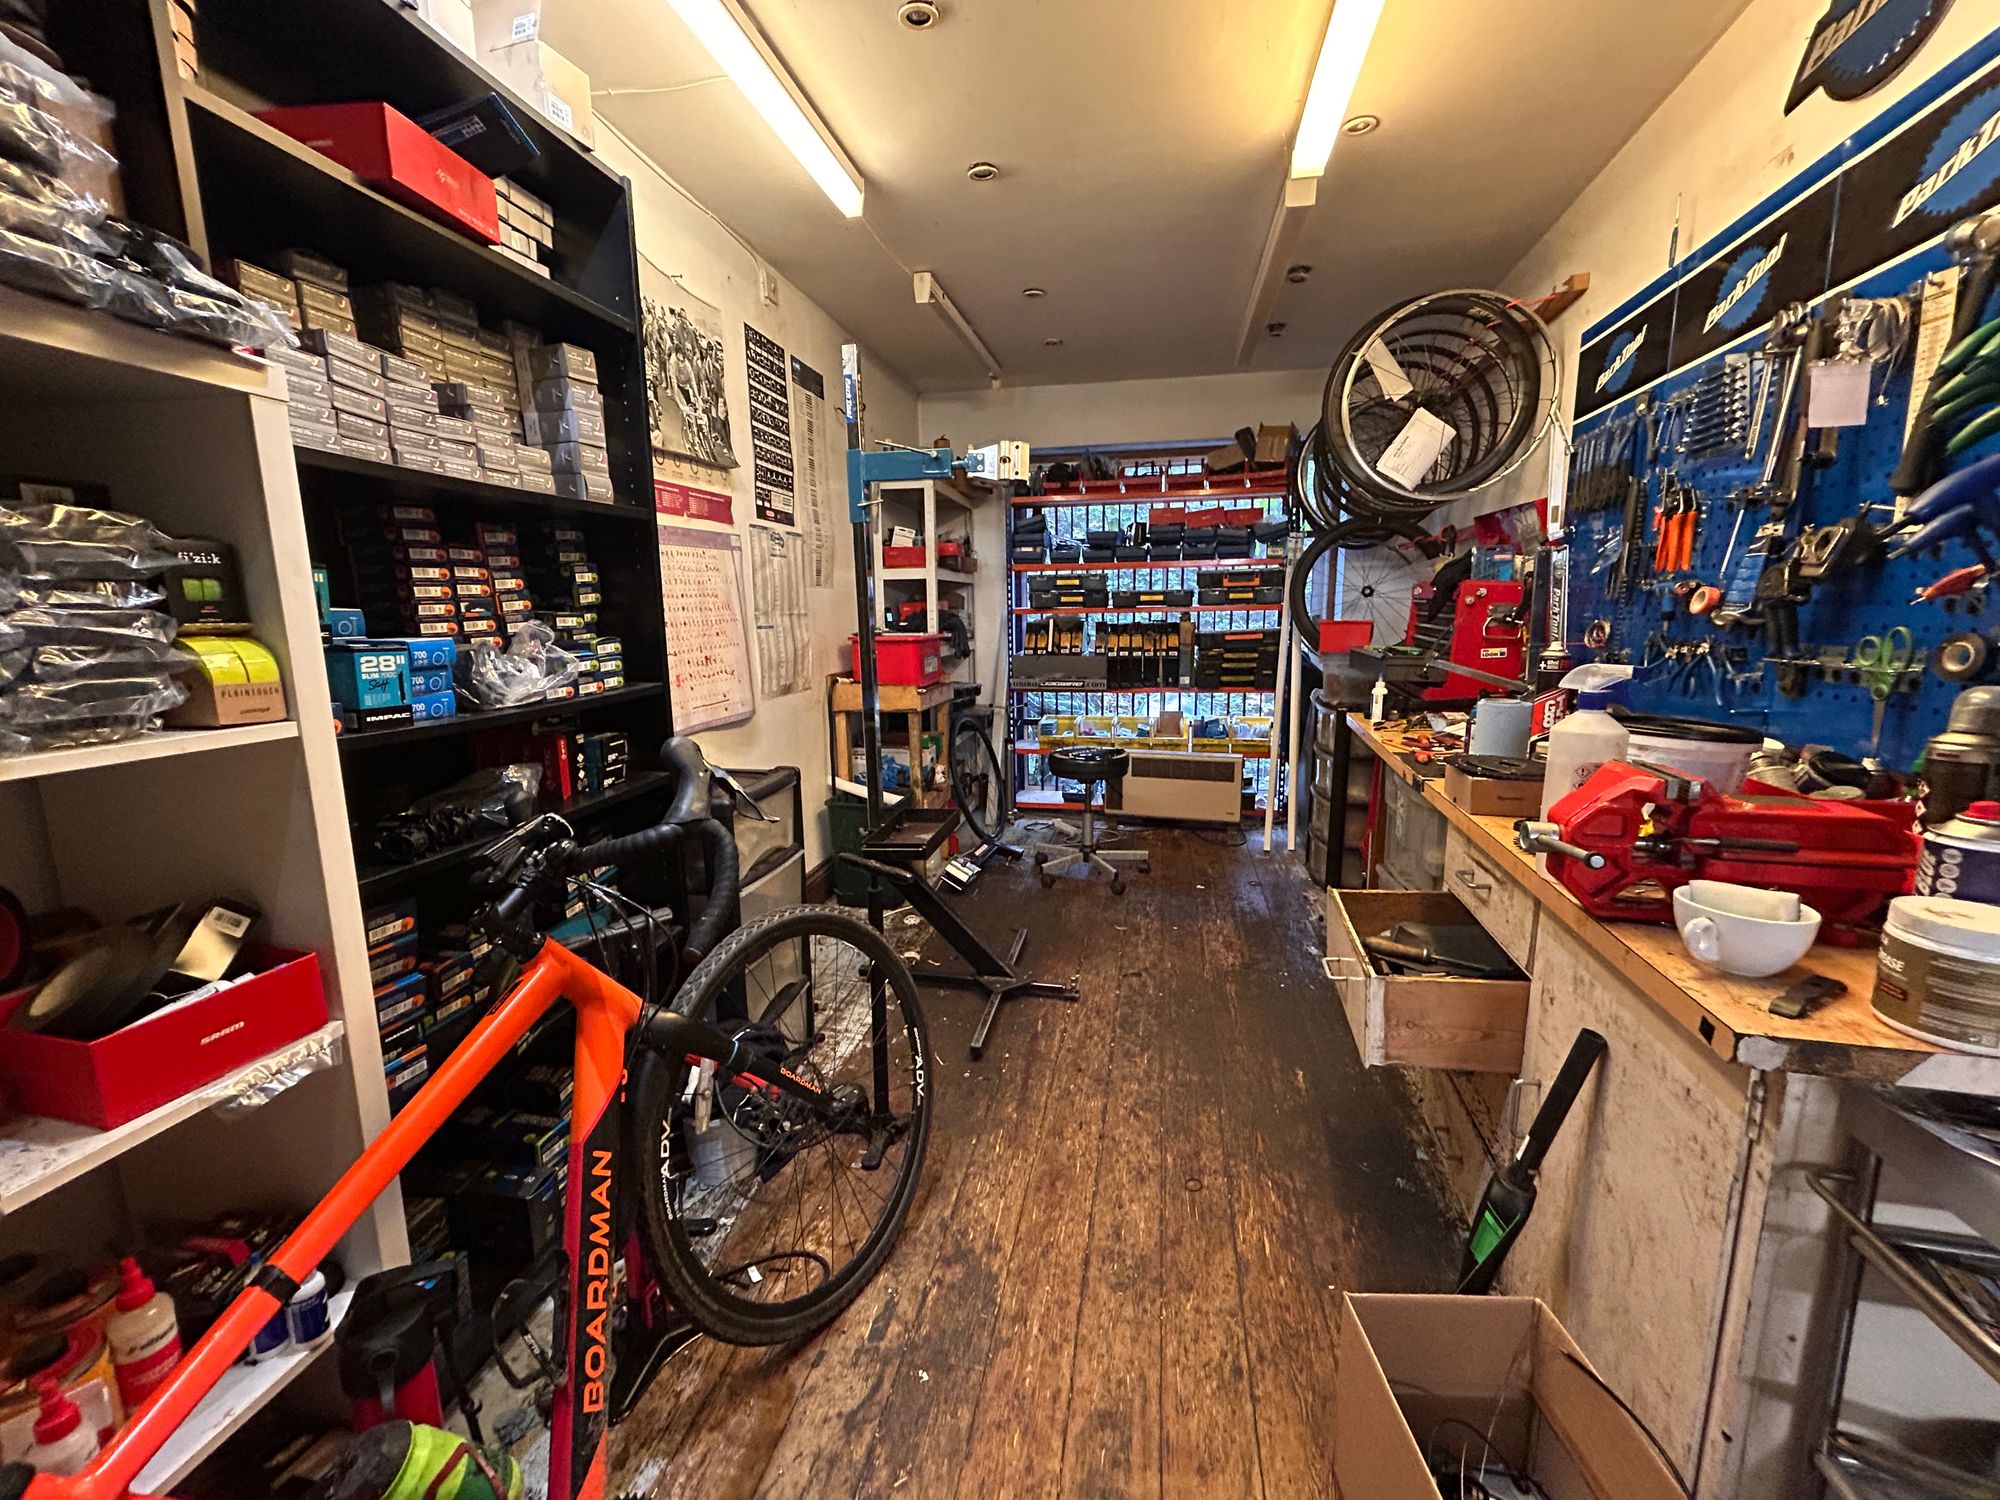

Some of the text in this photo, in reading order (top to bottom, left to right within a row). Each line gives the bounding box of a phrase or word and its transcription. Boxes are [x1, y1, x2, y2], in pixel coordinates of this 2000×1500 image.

[1703, 232, 1788, 334] ParkTool
[1594, 323, 1648, 394] ParkTool
[360, 655, 405, 672] 28"
[413, 651, 427, 659] 700
[411, 676, 424, 685] 700
[366, 712, 411, 722] IMPAC
[200, 1021, 245, 1046] SRAM
[780, 1066, 822, 1095] BOARDMAN
[583, 1151, 612, 1414] BOARDMAN
